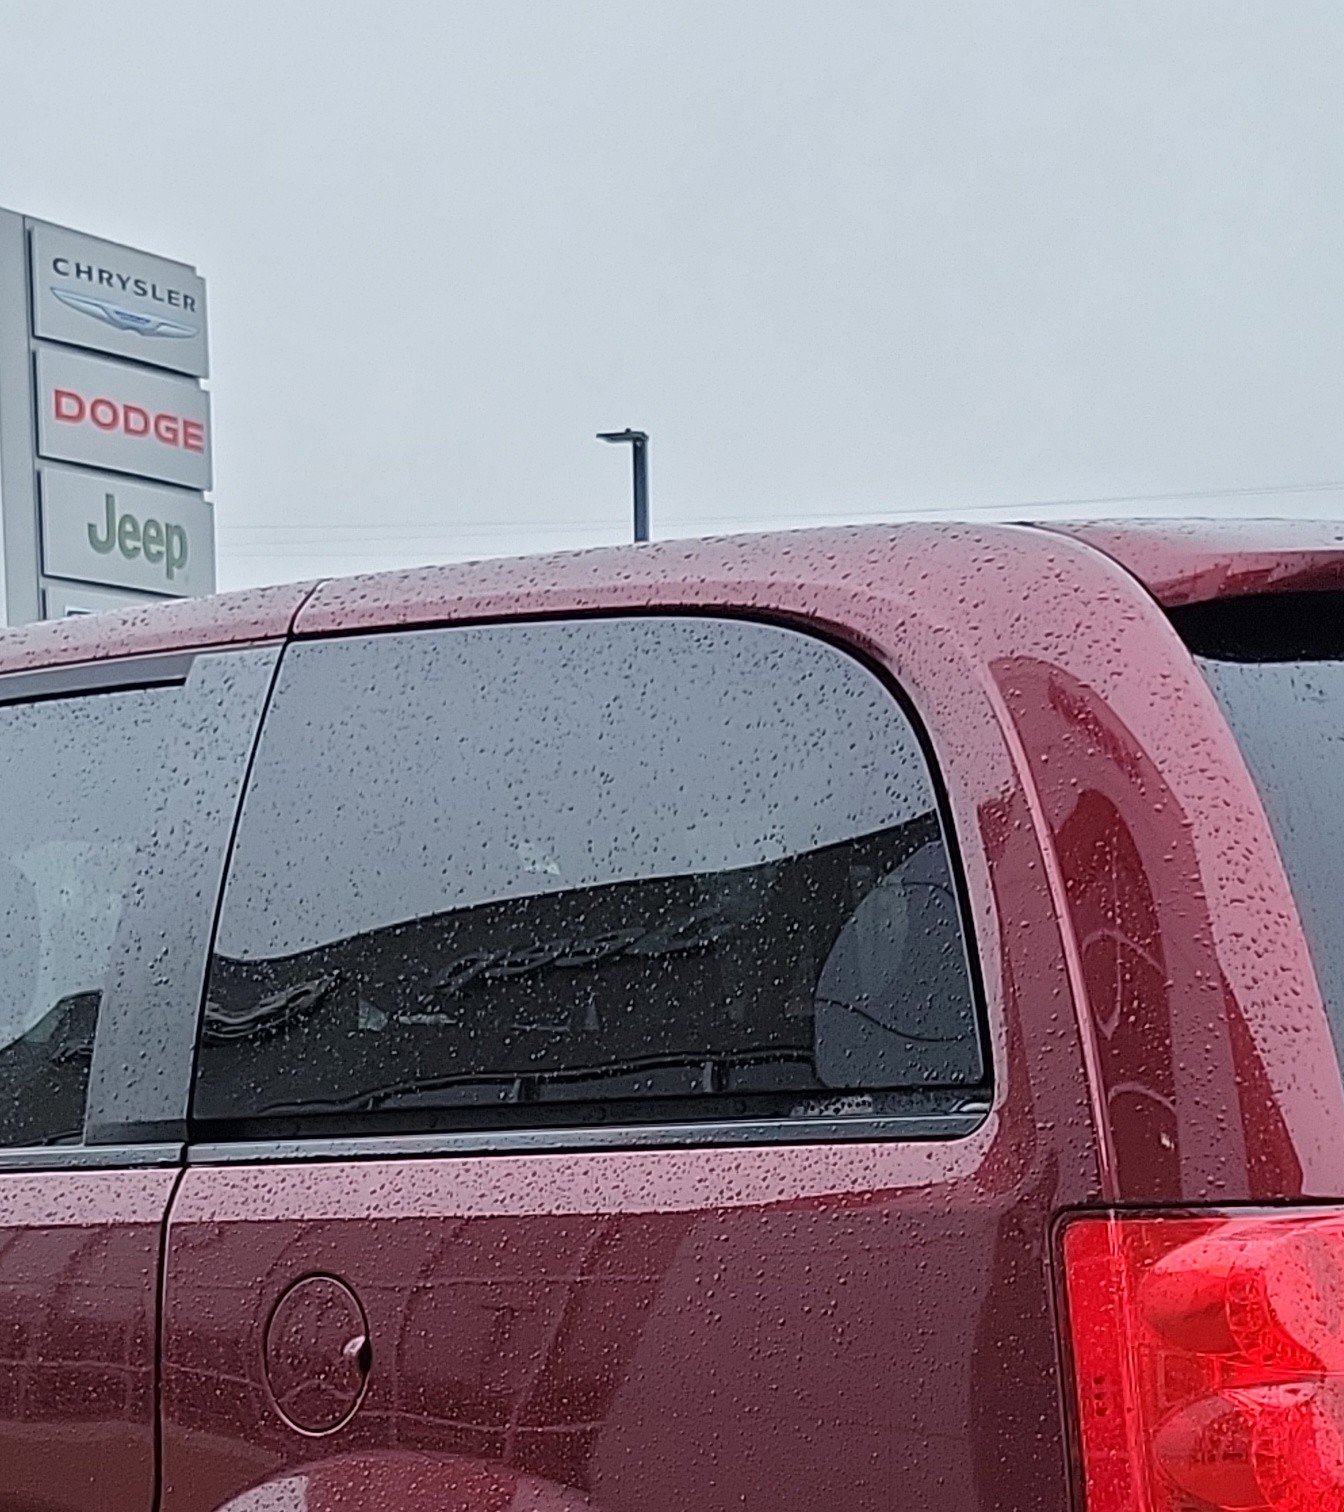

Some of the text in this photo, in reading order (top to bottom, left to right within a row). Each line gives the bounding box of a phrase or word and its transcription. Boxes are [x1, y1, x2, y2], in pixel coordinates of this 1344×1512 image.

[52, 257, 196, 313] CHRYSLER
[53, 388, 205, 454] DODGE
[87, 493, 188, 580] Jeep
